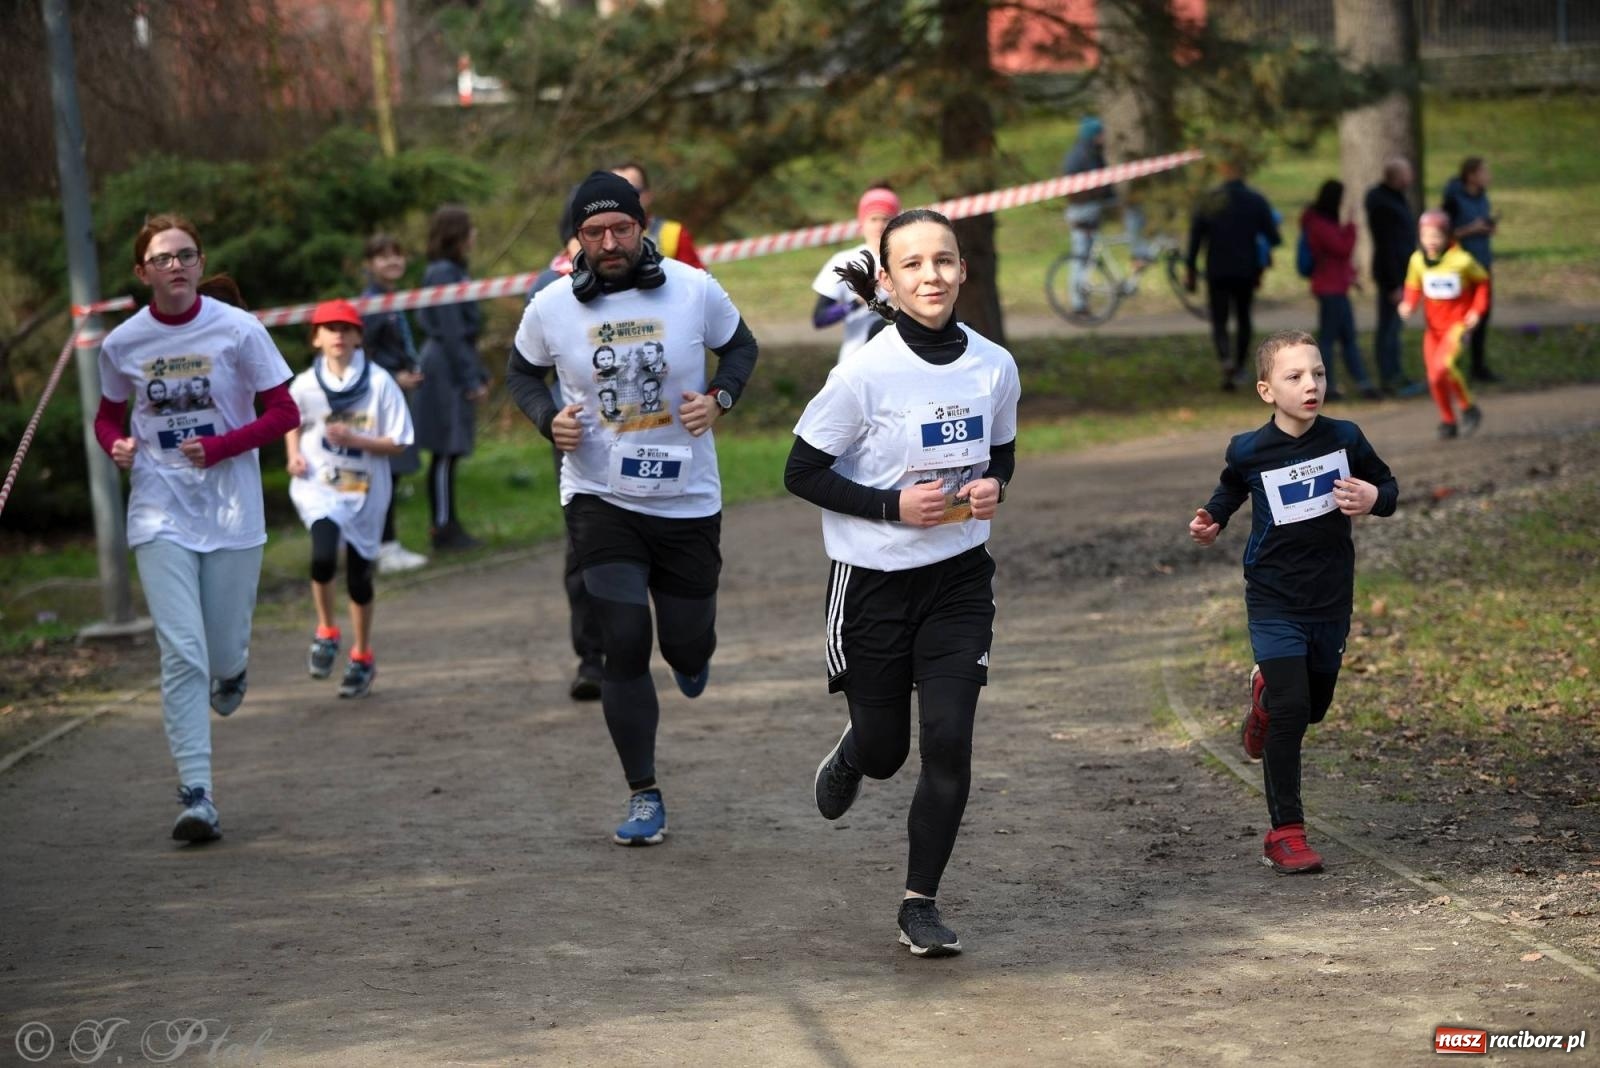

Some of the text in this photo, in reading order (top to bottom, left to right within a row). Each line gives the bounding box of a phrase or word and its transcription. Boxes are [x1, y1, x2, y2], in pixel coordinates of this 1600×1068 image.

[616, 321, 635, 329] TROPEM
[941, 420, 968, 443] 98
[638, 460, 664, 478] 84
[1302, 478, 1315, 498] 7
